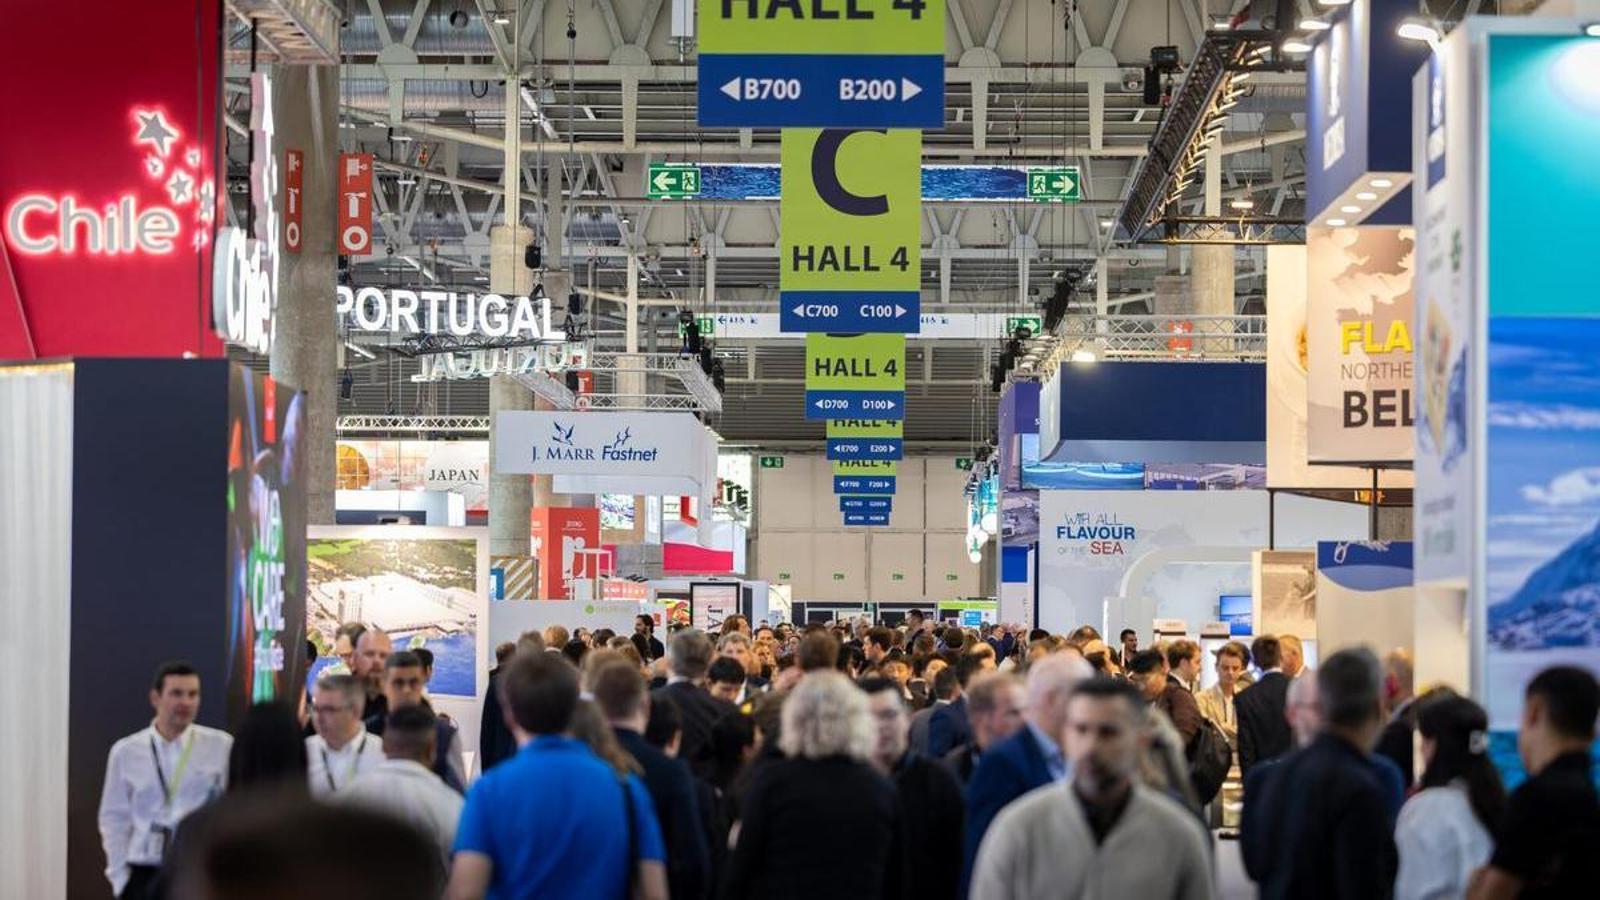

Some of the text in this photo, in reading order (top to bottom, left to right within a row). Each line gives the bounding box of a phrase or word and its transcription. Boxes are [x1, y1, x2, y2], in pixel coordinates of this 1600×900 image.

[744, 78, 897, 100] B700 B200
[811, 129, 889, 216] C
[8, 194, 180, 255] Chile
[793, 246, 910, 272] HALL 4
[806, 305, 892, 318] C700 C100
[1342, 320, 1413, 354] FLA
[815, 358, 898, 377] HALL 4
[1341, 361, 1413, 379] NORTHE
[824, 400, 887, 409] D700 D100
[546, 447, 594, 460] MARR
[602, 445, 658, 461] Fastnet
[841, 444, 888, 453] E700 E200
[429, 469, 479, 481] JAPAN
[1096, 512, 1123, 526] ALL
[1057, 526, 1135, 540] FLAVOUR
[1090, 541, 1124, 555] SEA
